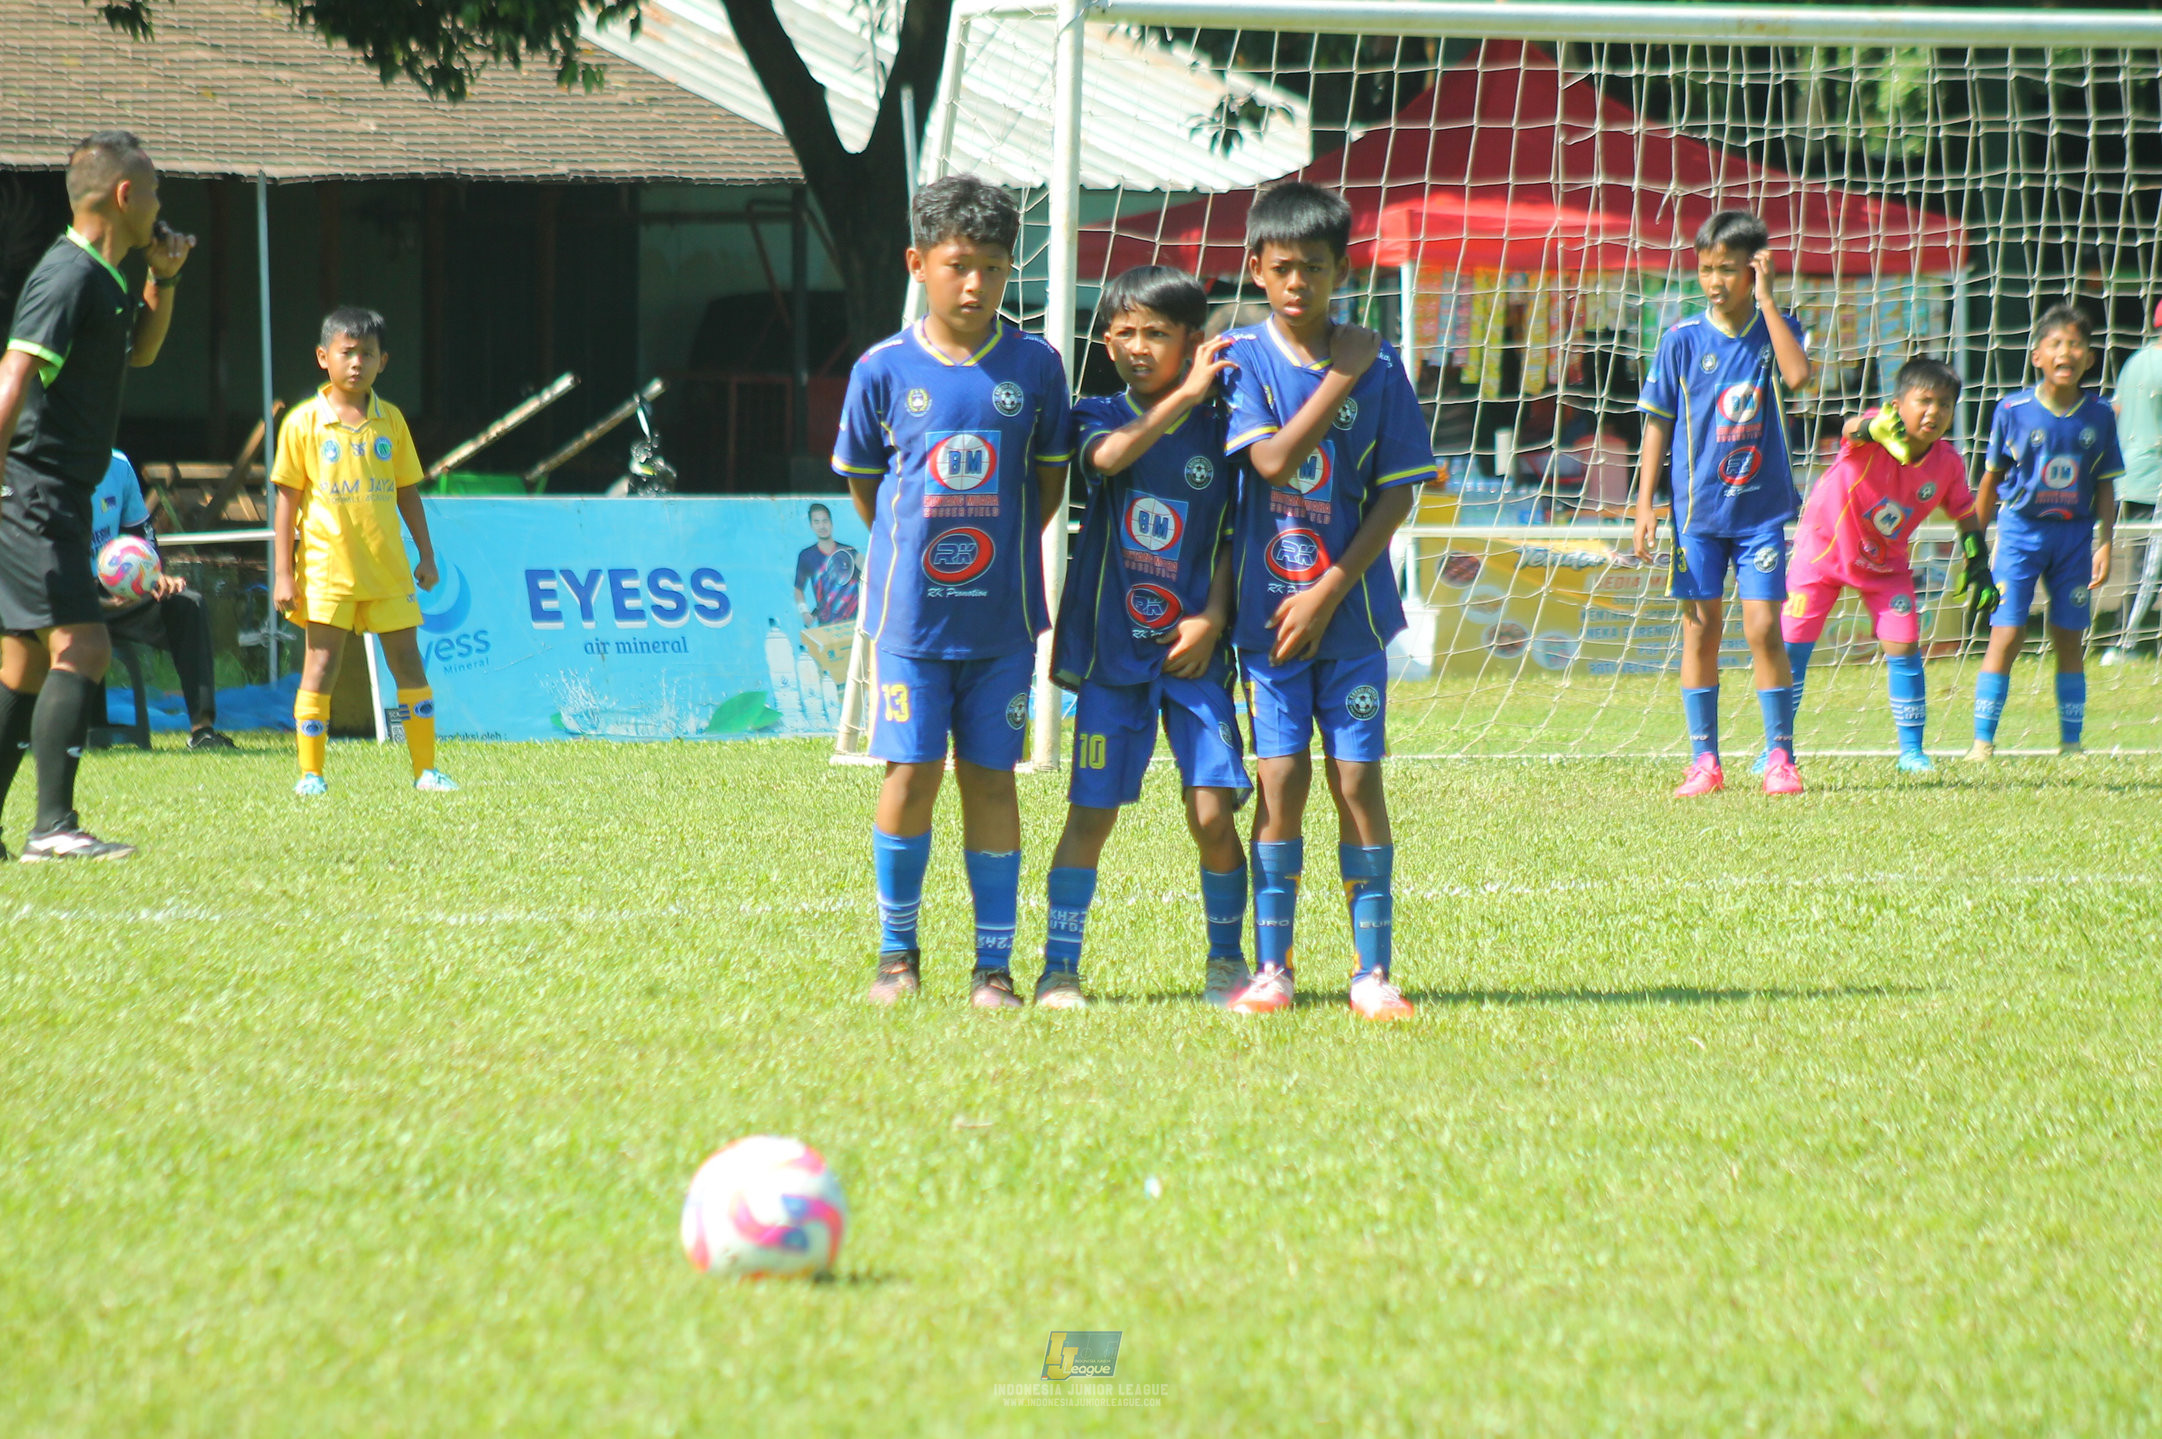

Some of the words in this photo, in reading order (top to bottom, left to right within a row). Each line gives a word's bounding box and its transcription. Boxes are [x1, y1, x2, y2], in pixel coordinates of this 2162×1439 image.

[949, 450, 983, 475] BM
[524, 567, 733, 629] EYESS
[421, 629, 493, 678] yess
[584, 638, 611, 655] air
[615, 636, 690, 654] mineral
[443, 657, 490, 675] Mineral
[881, 683, 911, 722] 13
[1079, 733, 1106, 769] 10
[1256, 919, 1290, 927] URO
